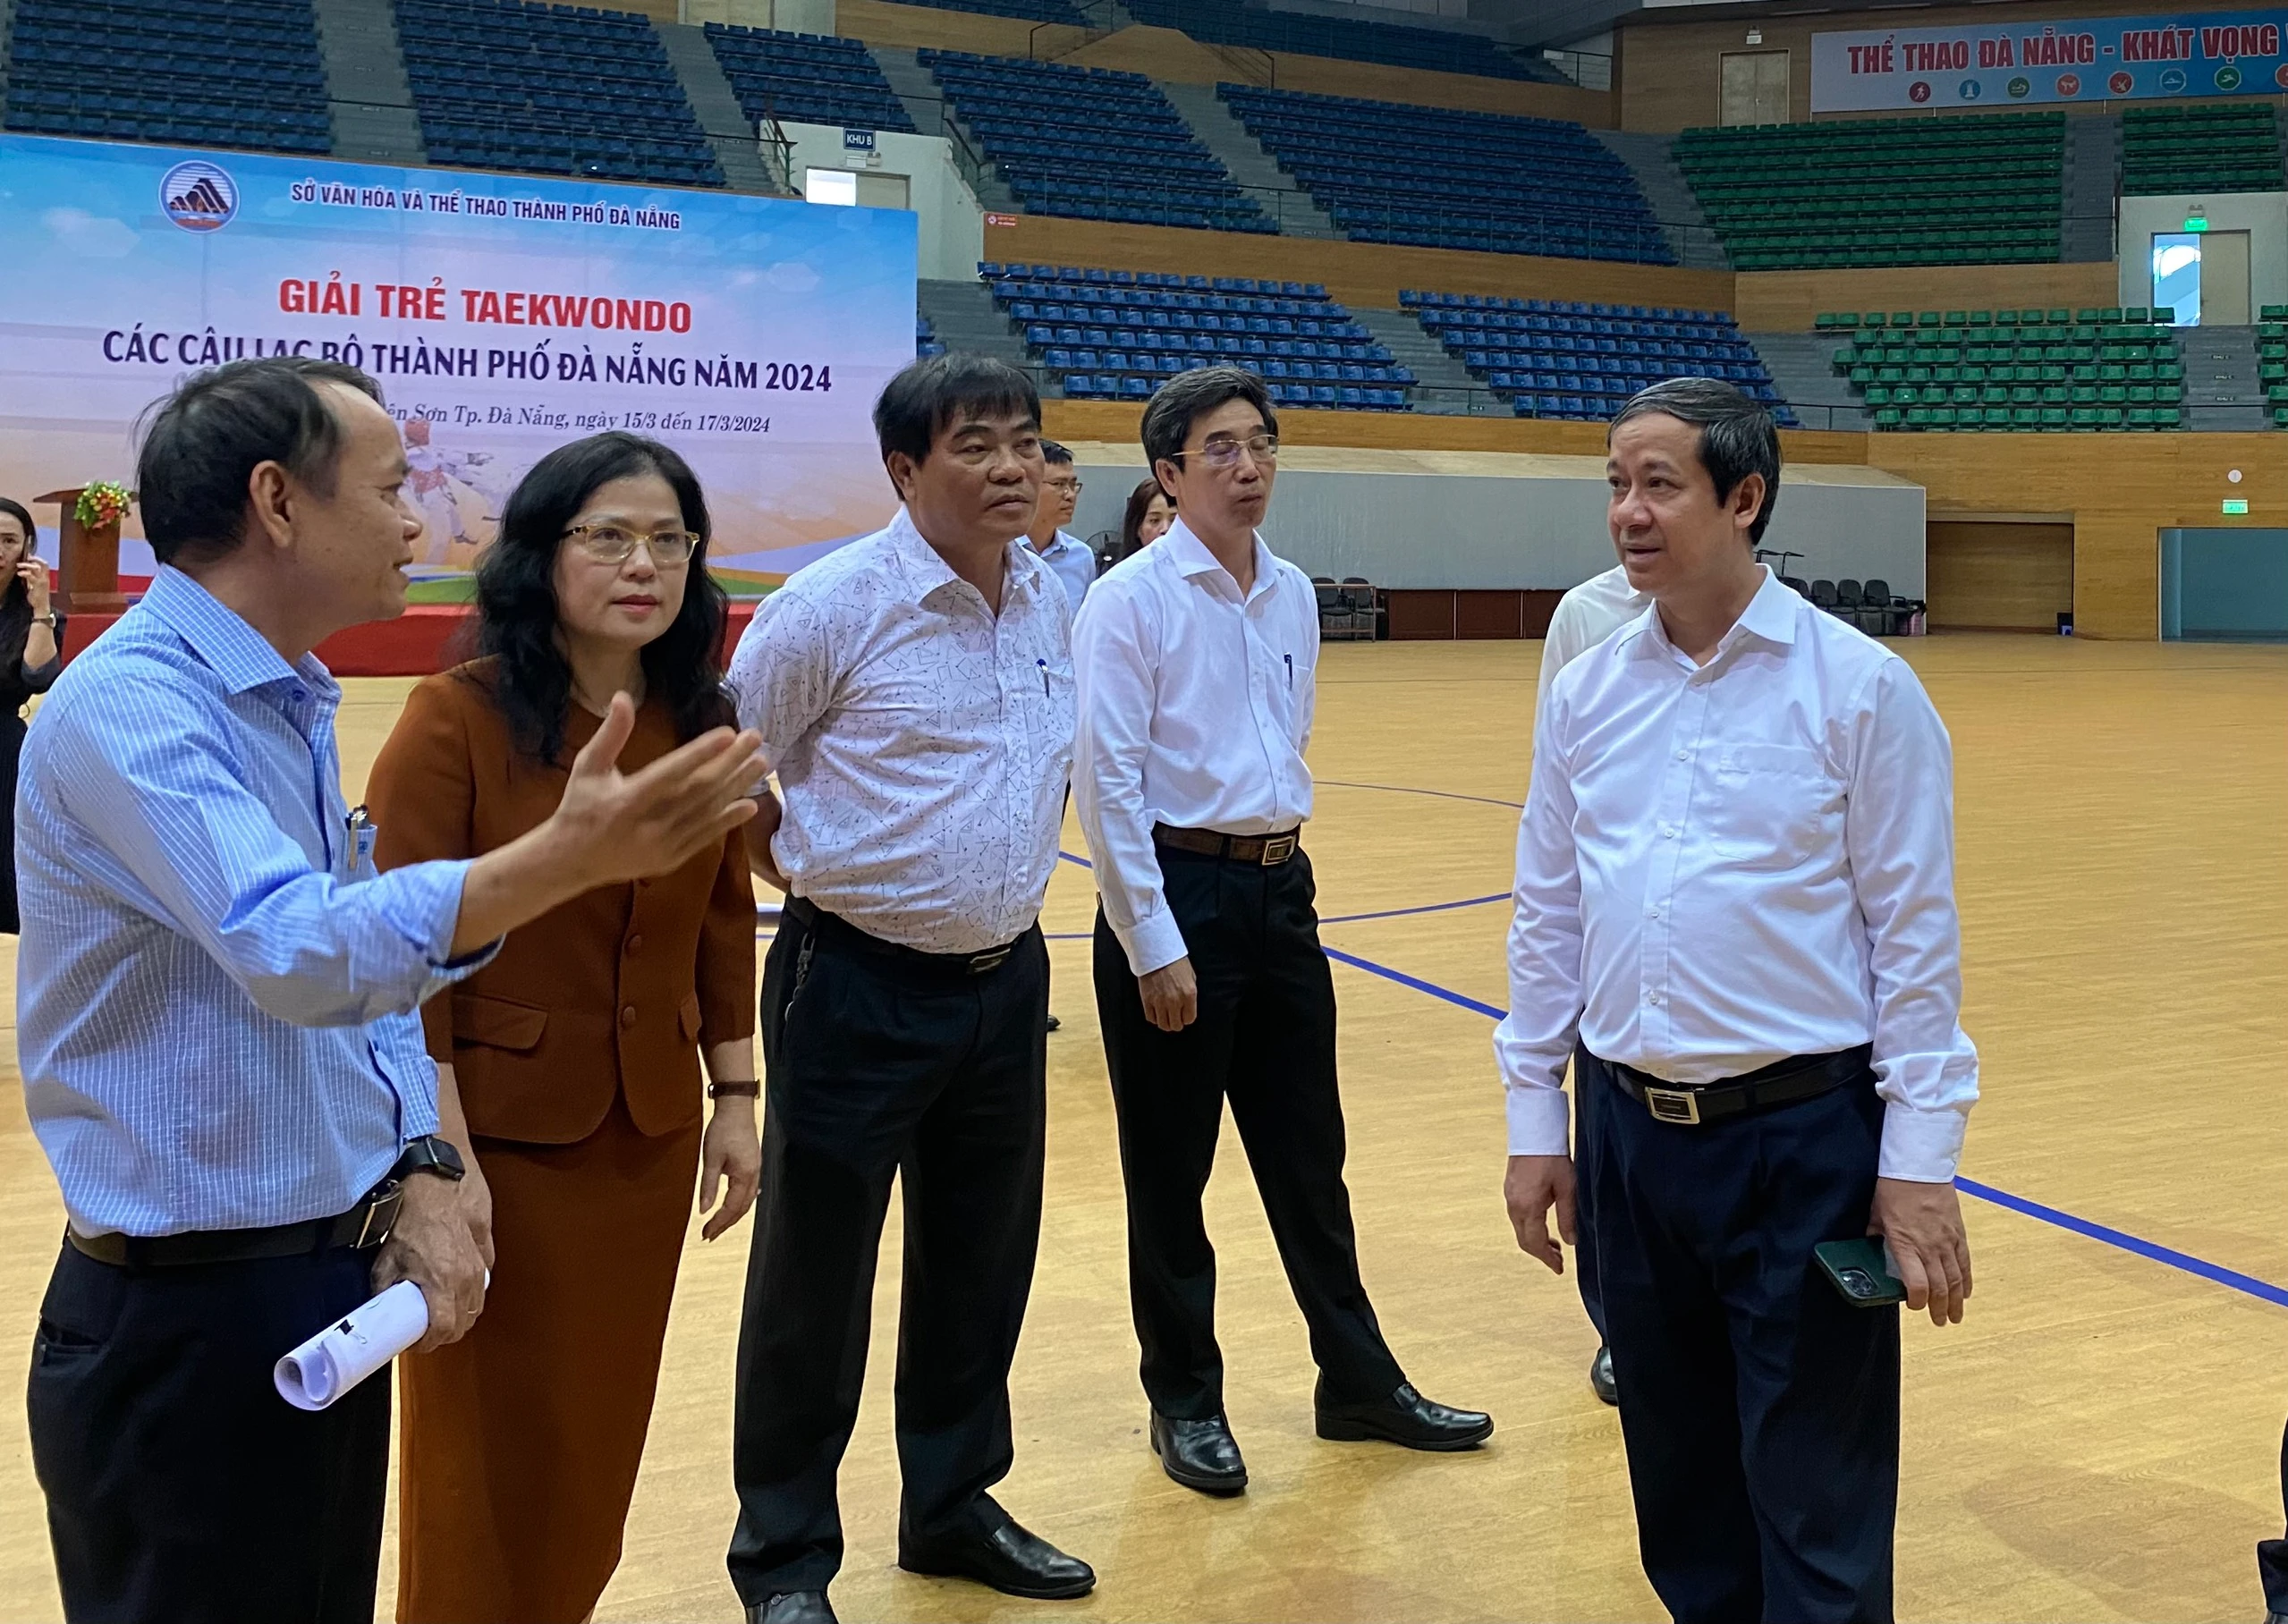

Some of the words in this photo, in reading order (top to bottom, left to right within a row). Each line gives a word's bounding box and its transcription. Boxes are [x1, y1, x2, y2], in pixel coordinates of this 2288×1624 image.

[1847, 34, 1895, 74] THỂ
[1902, 40, 1969, 72] THAO
[1978, 34, 2014, 69] ĐÀ
[2022, 27, 2095, 66] NẴNG
[2123, 24, 2194, 62] KHÁT
[2201, 24, 2278, 63] VỌNG
[846, 133, 866, 145] KHU
[866, 135, 873, 146] B
[292, 179, 316, 201] SỞ
[321, 182, 356, 206] VĂN
[361, 186, 396, 208] HÓA
[403, 190, 423, 210] VÀ
[429, 190, 461, 213] THỂ
[465, 197, 507, 216] THAO
[513, 198, 566, 221] THÀNH
[572, 200, 606, 223] PHỐ
[609, 205, 631, 225] ĐÀ
[636, 206, 681, 229] NẴNG
[279, 270, 361, 317] GIẢI
[375, 276, 446, 321] TRẺ
[461, 289, 691, 334] TAEKWONDO
[103, 322, 170, 364] CÁC
[179, 326, 244, 366] CÂU
[371, 336, 478, 377] THÀNH
[488, 338, 551, 381] PHỐ
[557, 344, 597, 382] ĐÀ
[606, 342, 686, 386] NẴNG
[695, 353, 758, 389] NĂM
[766, 362, 832, 392] 2024
[411, 402, 447, 422] Sơn
[453, 404, 482, 427] Tp.
[487, 405, 513, 425] Đà
[517, 403, 570, 430] Nẵng,
[574, 410, 619, 431] ngày
[623, 411, 657, 429] 15/3
[660, 410, 692, 430] đến
[697, 414, 771, 433] 17/3/2024
